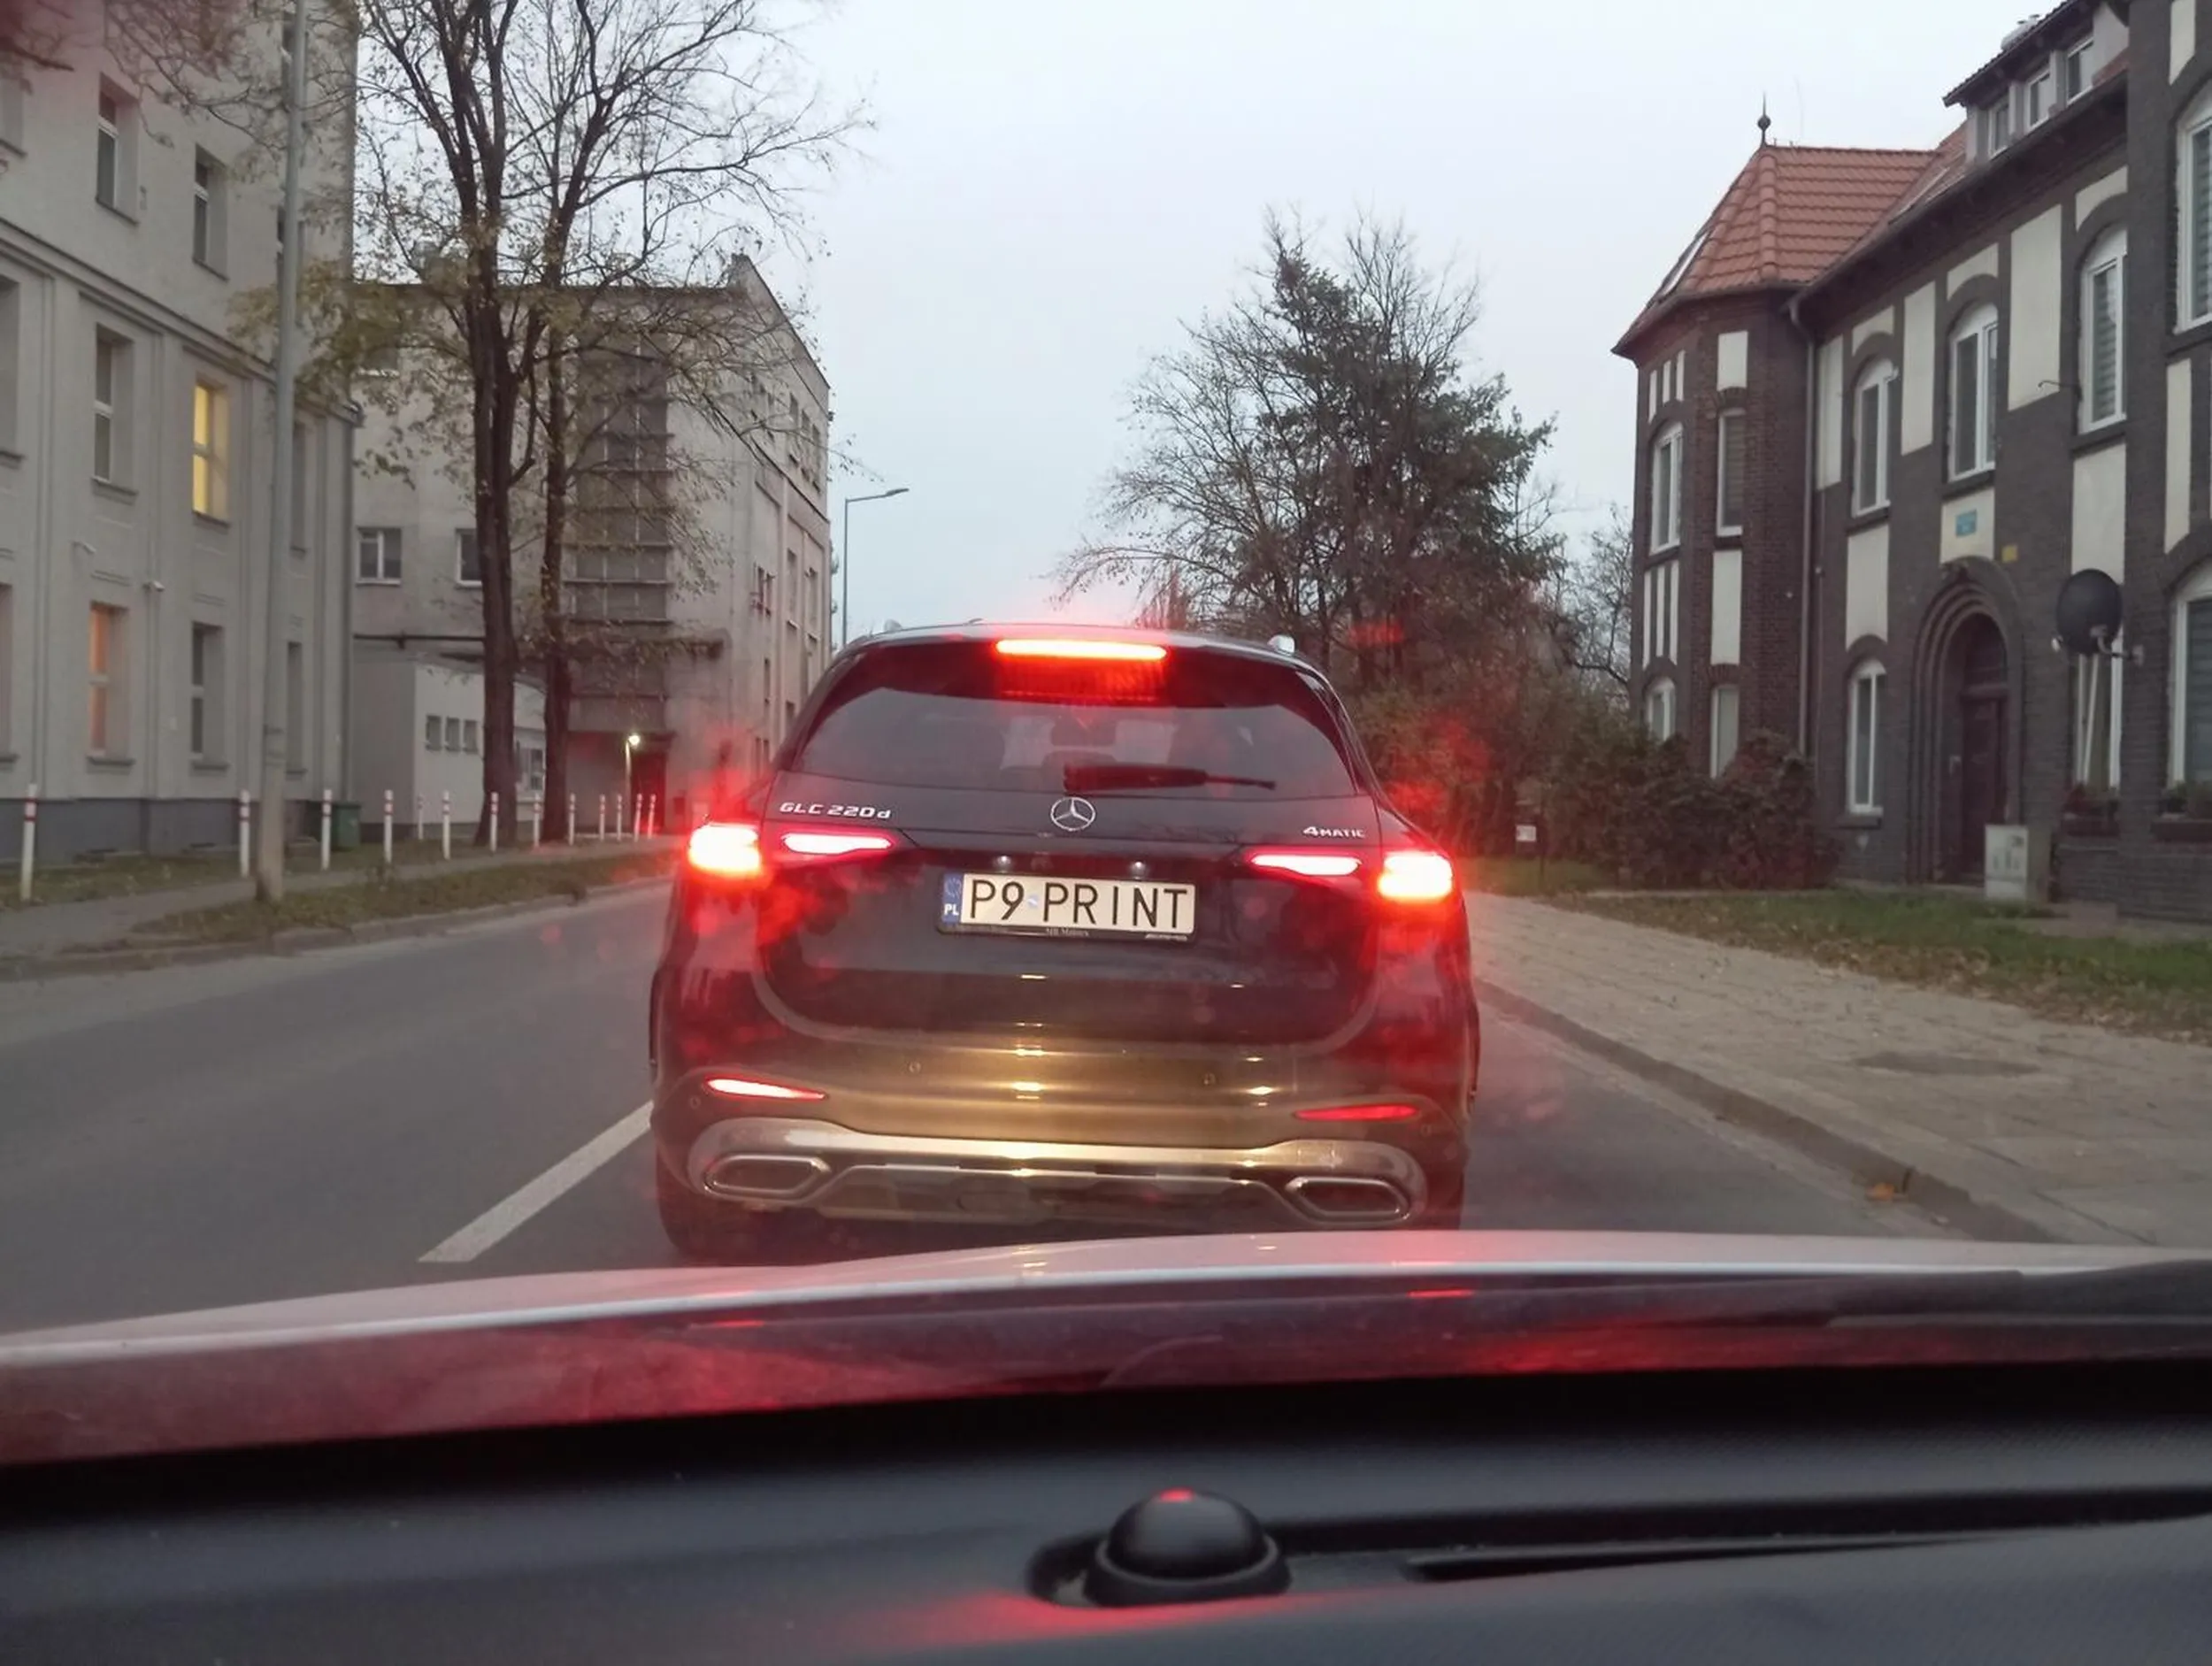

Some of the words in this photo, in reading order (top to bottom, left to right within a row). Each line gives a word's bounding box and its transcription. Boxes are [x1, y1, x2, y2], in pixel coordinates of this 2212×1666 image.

[780, 802, 823, 814] GLC
[827, 804, 891, 818] 220d
[1303, 825, 1365, 838] 4MATIC
[944, 903, 959, 916] PL
[971, 879, 1025, 920] P9
[1043, 882, 1187, 929] PRINT
